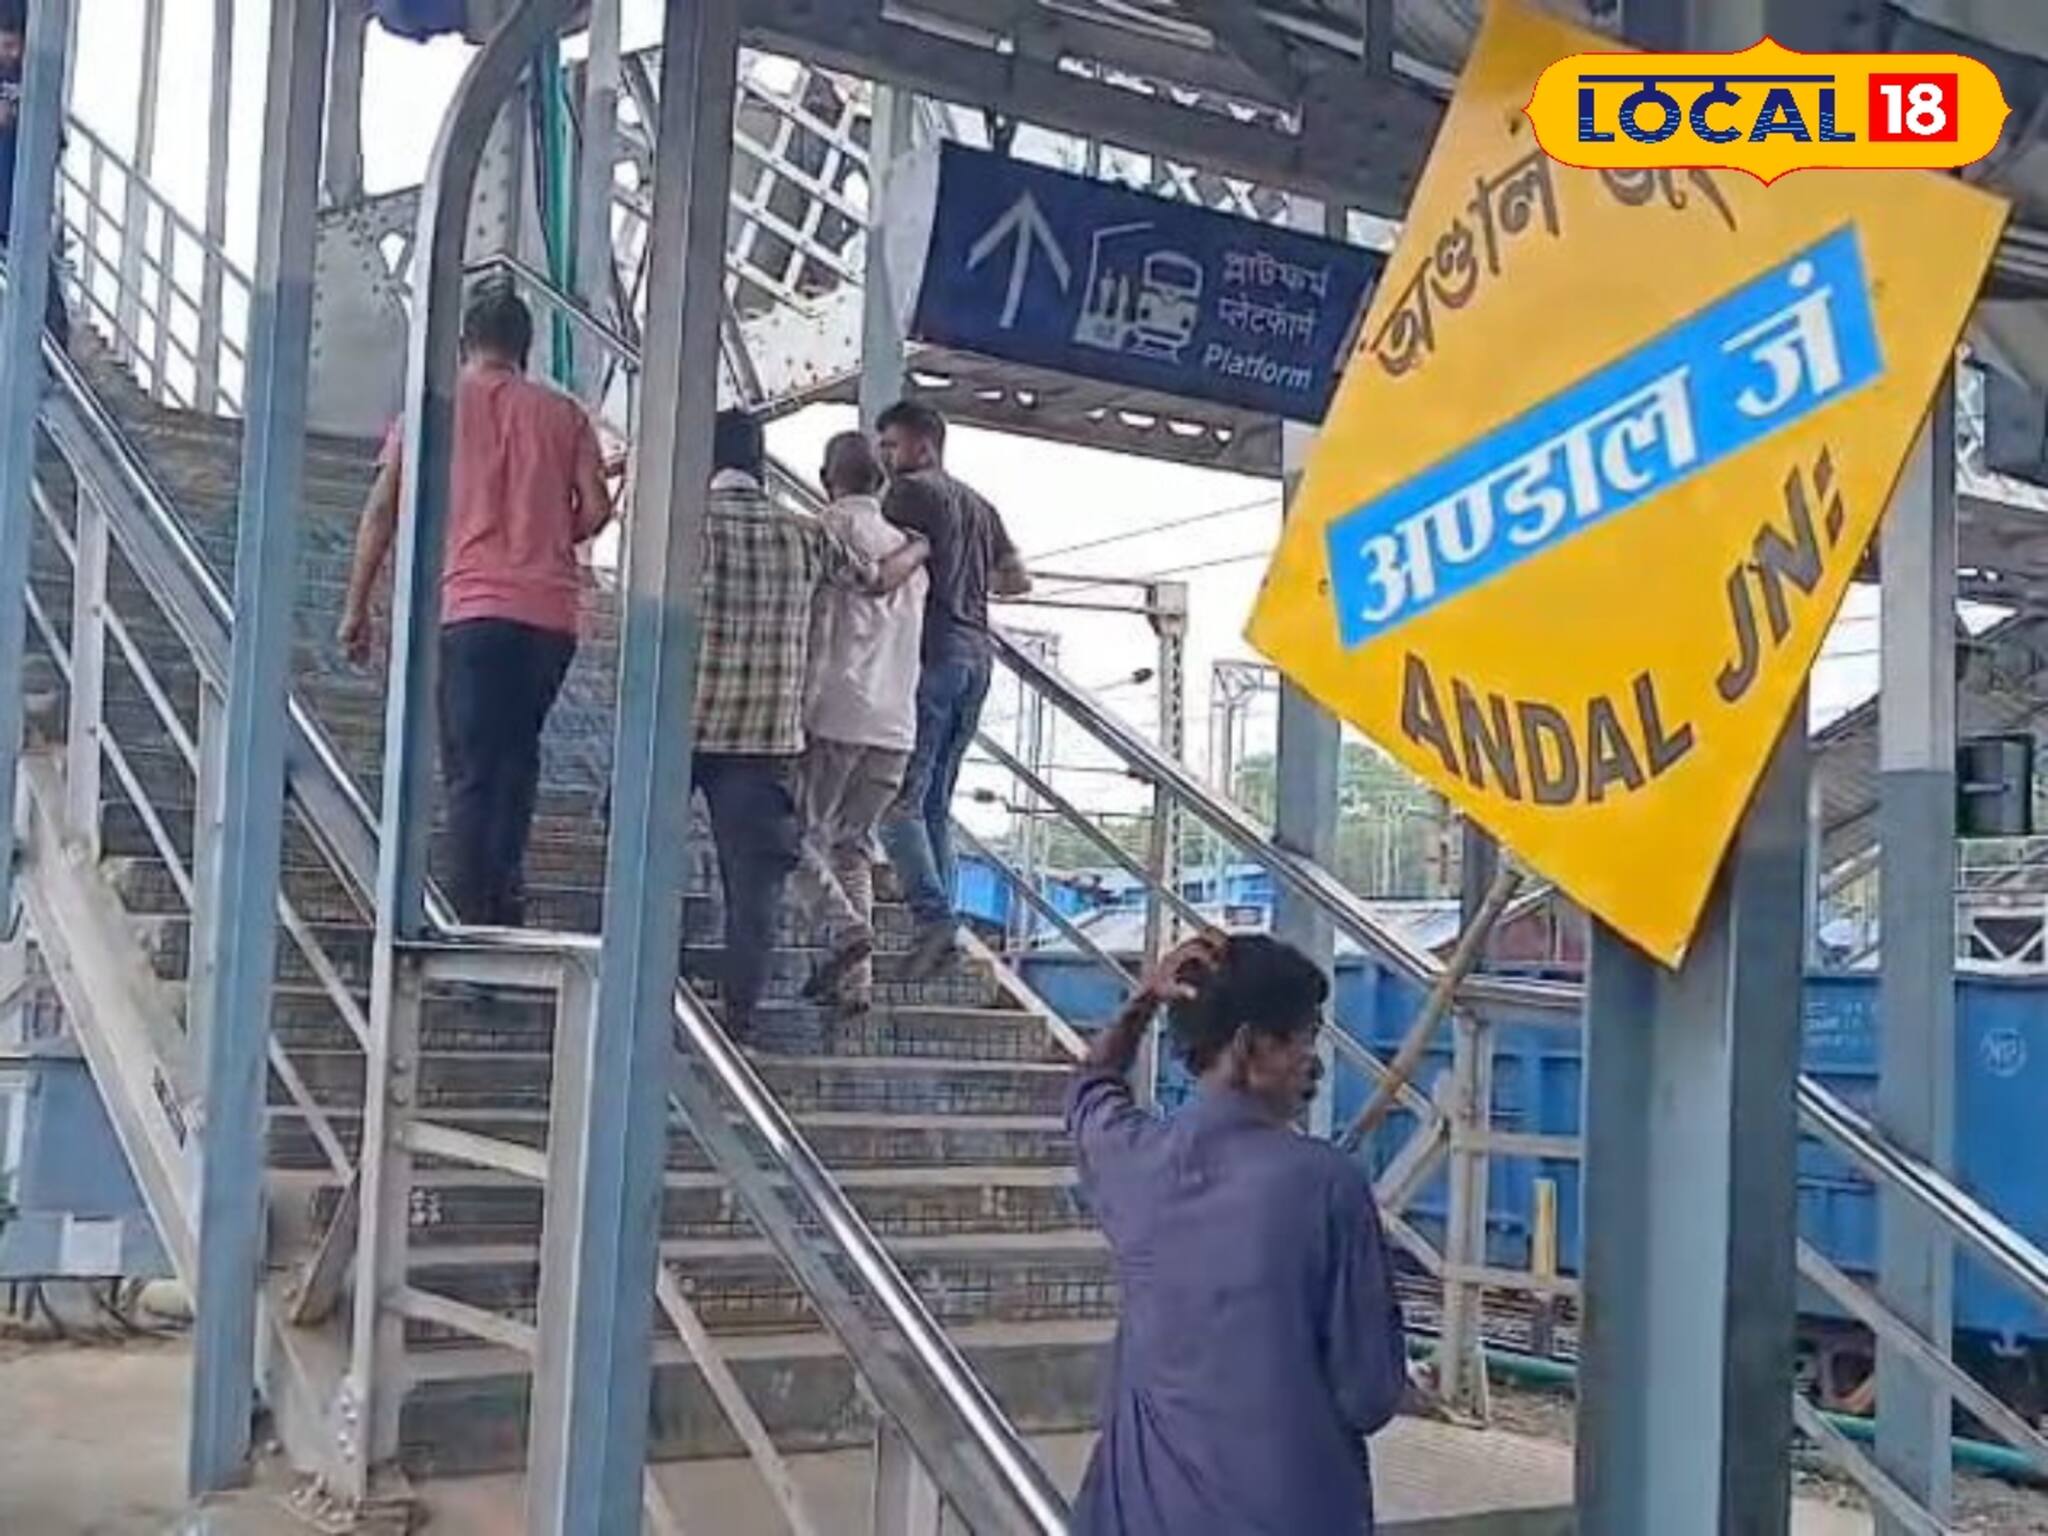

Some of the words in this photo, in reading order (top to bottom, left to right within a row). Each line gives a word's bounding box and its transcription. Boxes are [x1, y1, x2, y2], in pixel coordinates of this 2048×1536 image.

[1202, 342, 1313, 391] Platform
[1359, 364, 1698, 623] अण्डाल
[1720, 259, 1844, 418] जं
[1400, 649, 1698, 807] ANDAL
